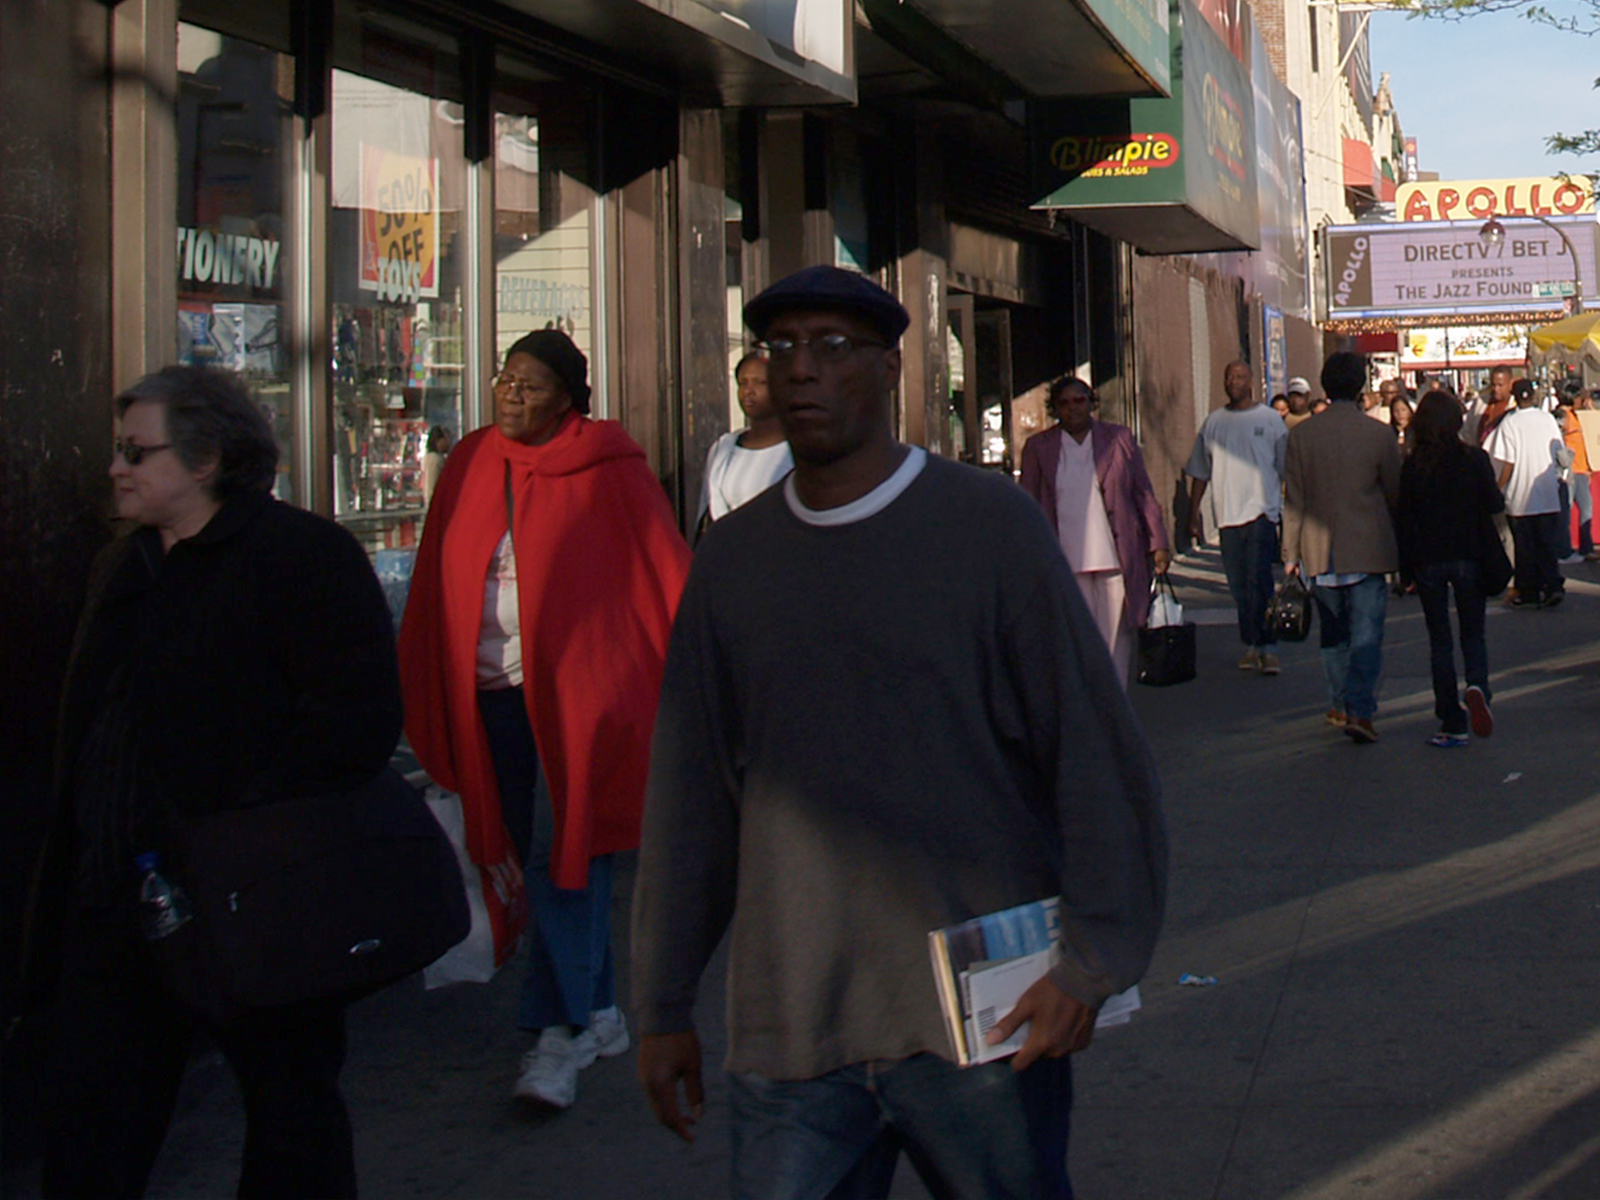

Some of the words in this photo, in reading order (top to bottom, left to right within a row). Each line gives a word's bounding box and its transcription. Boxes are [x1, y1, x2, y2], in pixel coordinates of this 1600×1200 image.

[1050, 133, 1170, 170] Blimpie
[1113, 165, 1149, 177] SALADS
[1404, 182, 1585, 222] APOLLO
[388, 228, 423, 268] OFF
[1404, 241, 1489, 262] DIRECTV
[1512, 240, 1549, 257] BET
[377, 257, 421, 303] TOYS
[1335, 237, 1368, 305] APOLLO
[1451, 267, 1514, 279] PRESENTS
[1395, 284, 1427, 300] THE
[1433, 283, 1471, 299] JAZZ
[1477, 281, 1548, 296] FOUND
